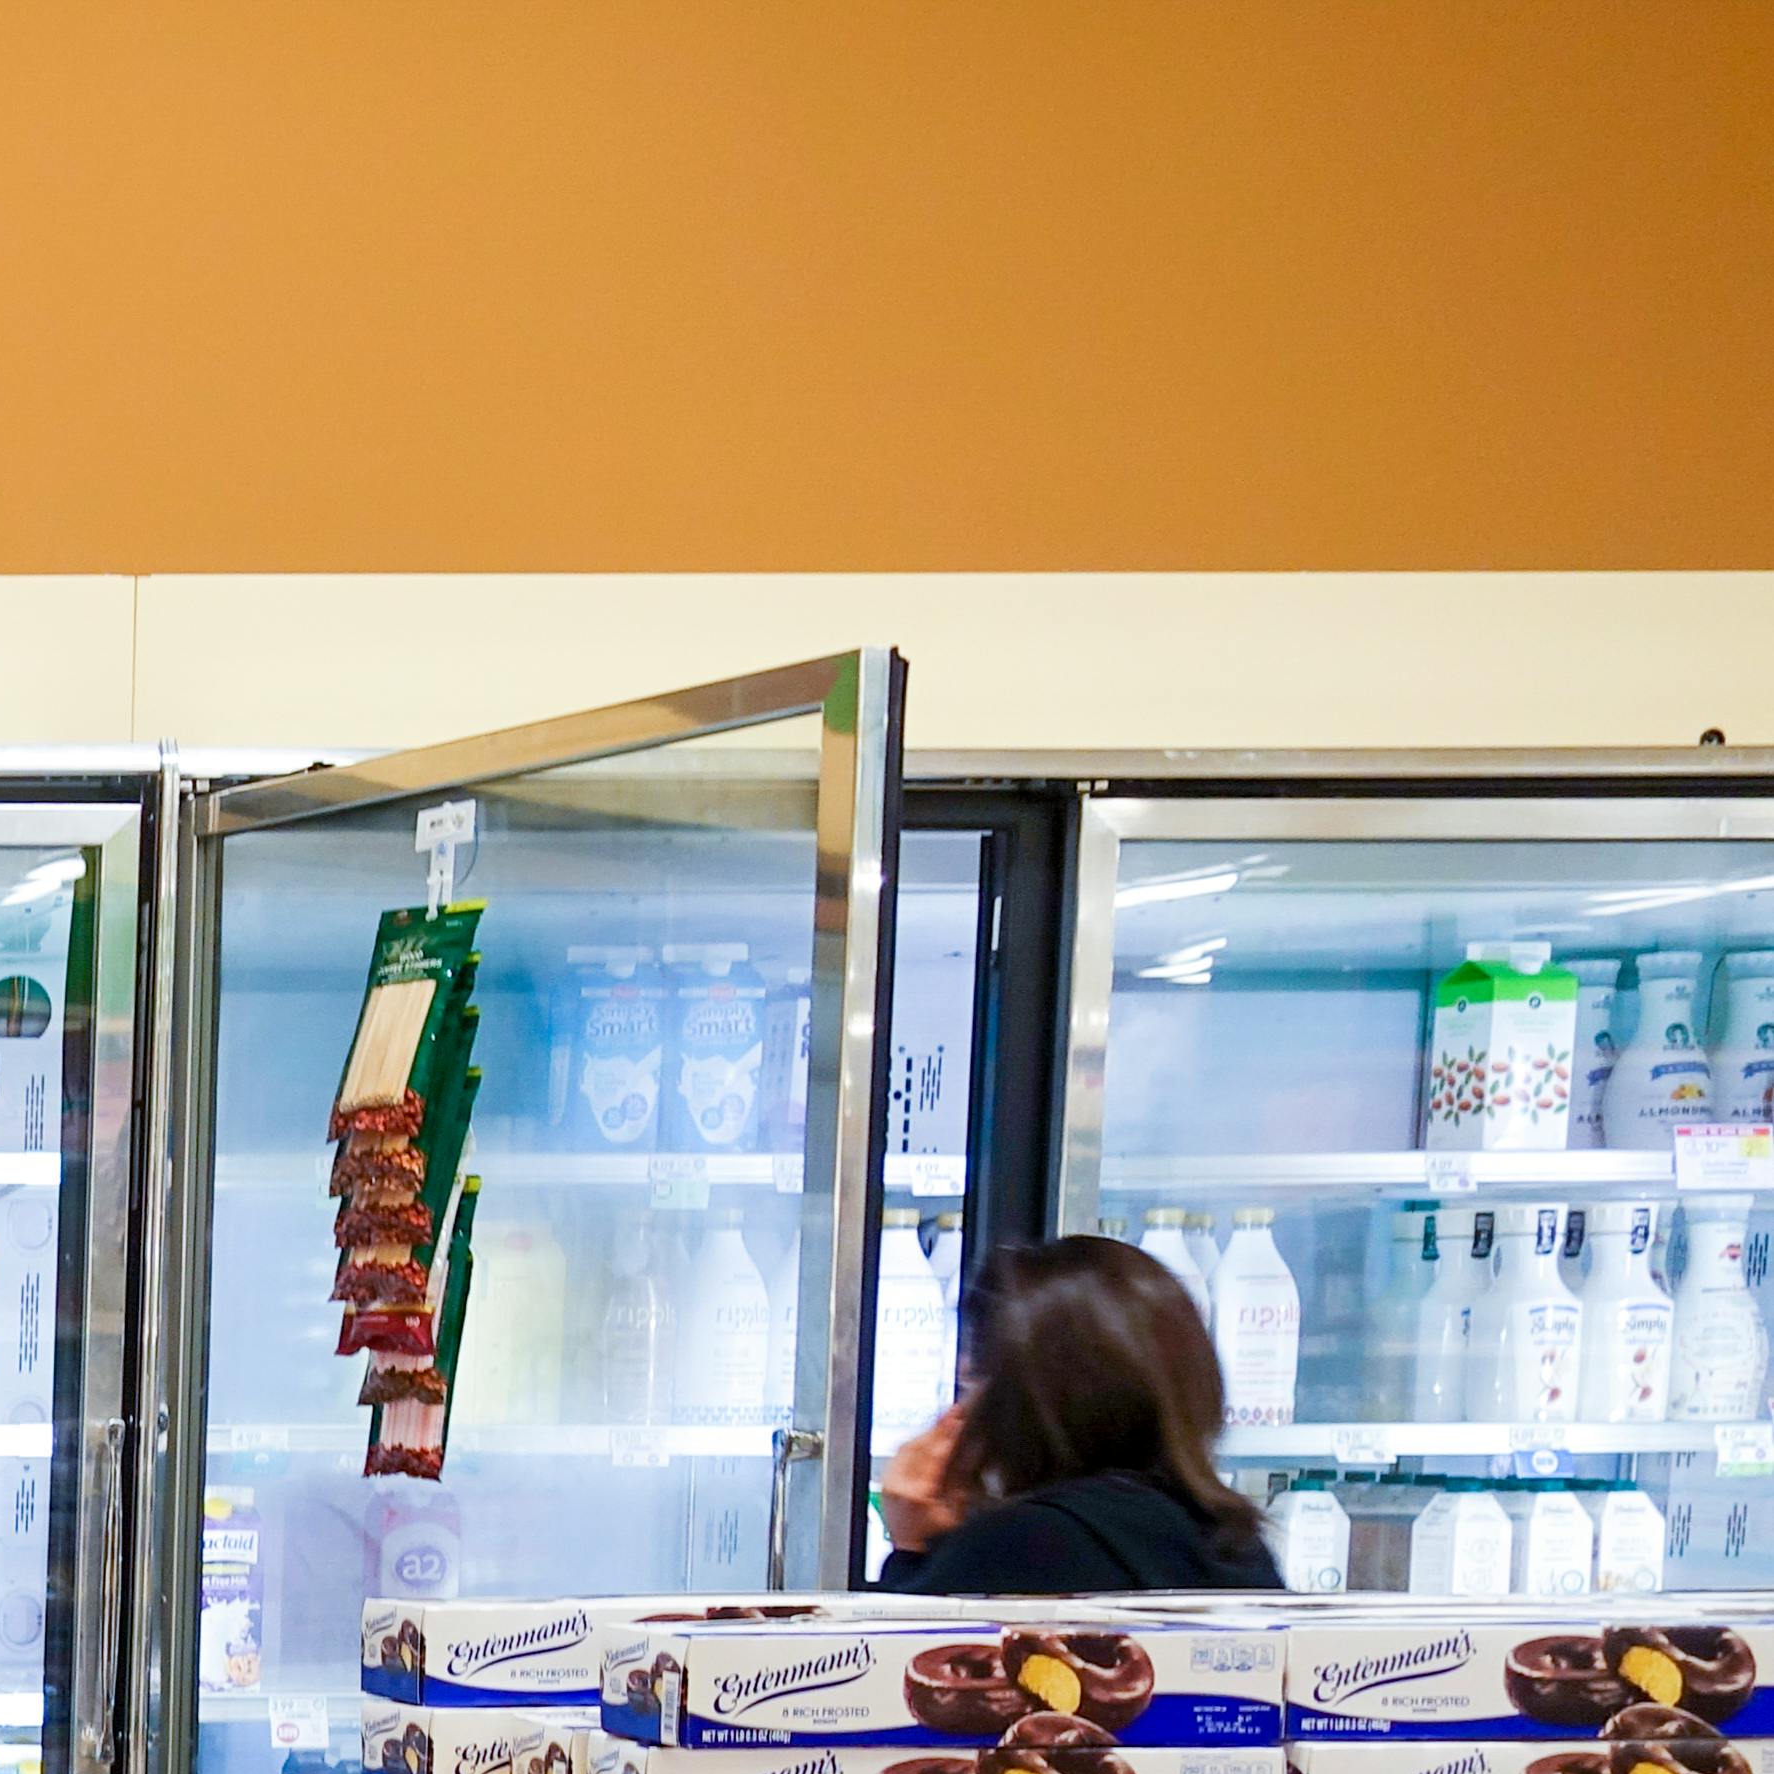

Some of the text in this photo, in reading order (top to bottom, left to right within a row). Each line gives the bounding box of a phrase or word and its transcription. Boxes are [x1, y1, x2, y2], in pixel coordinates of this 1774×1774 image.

[401, 1556, 441, 1580] a2
[448, 1608, 593, 1677] Entenmann's
[713, 1638, 878, 1715] Entenmann's
[1314, 1629, 1477, 1704] Entenmann's
[793, 1706, 819, 1718] RICH
[822, 1705, 870, 1717] FROSTED
[1392, 1697, 1416, 1706] RICH
[1420, 1696, 1470, 1706] FROSTED
